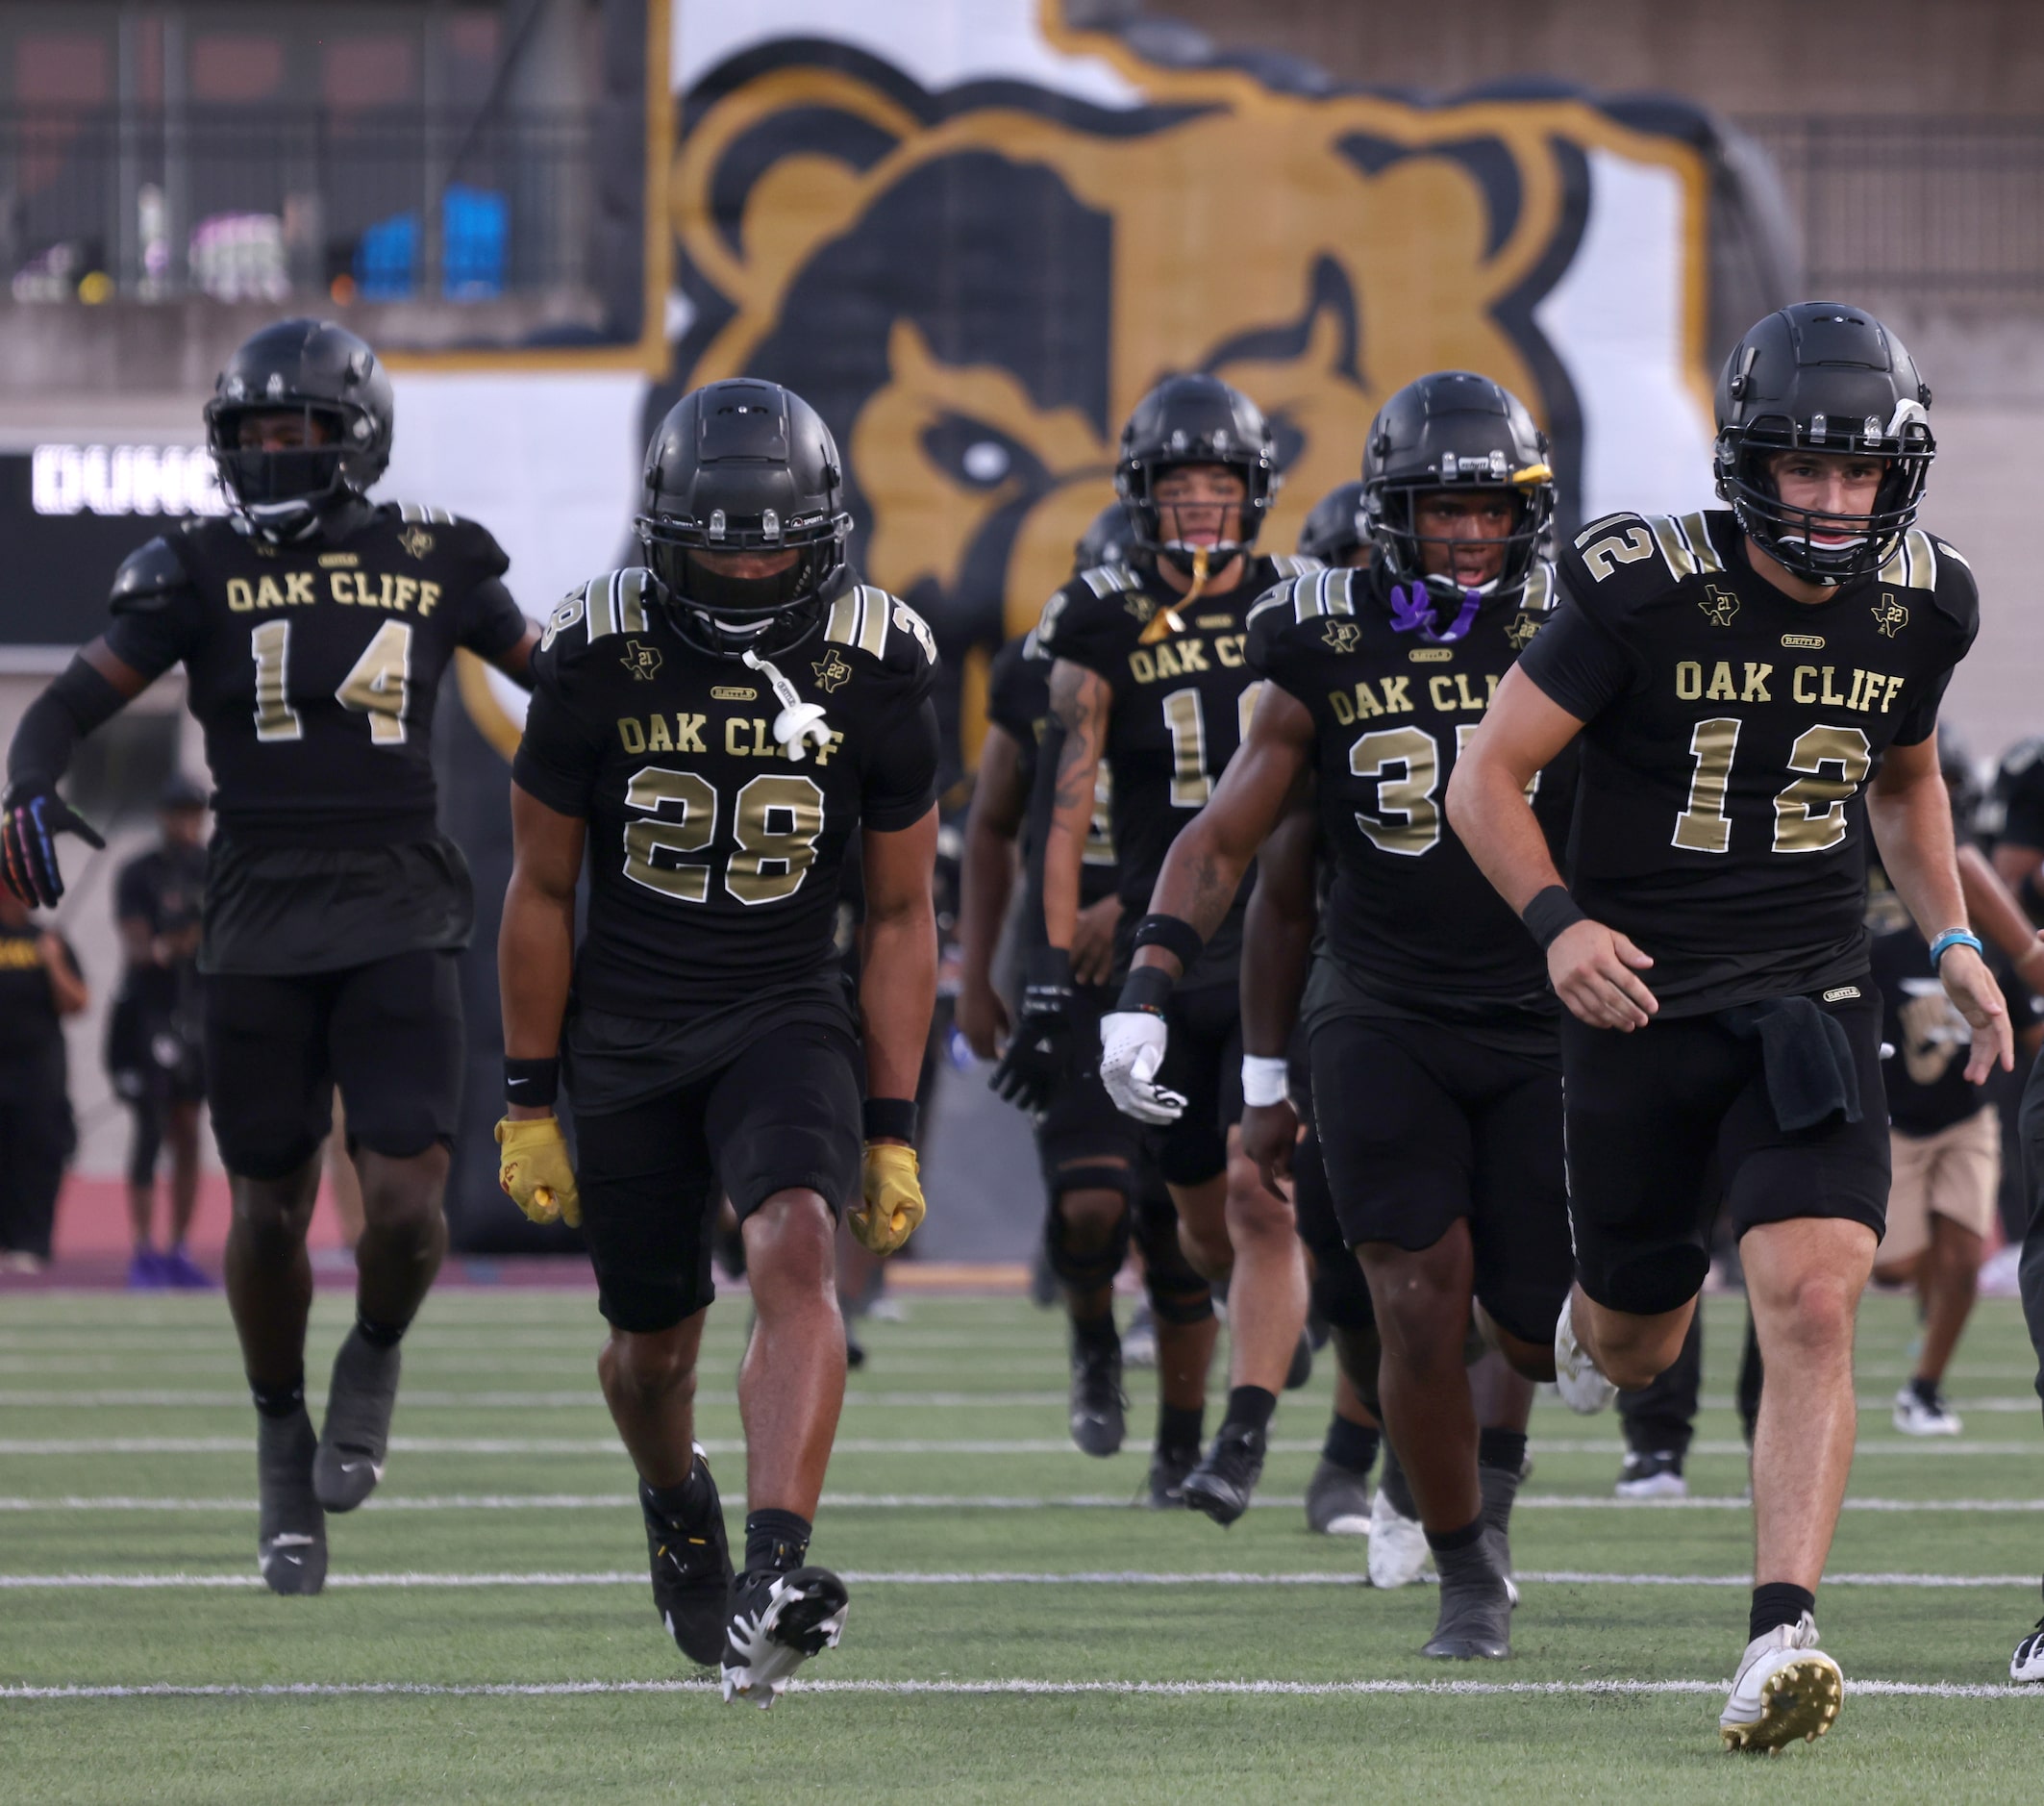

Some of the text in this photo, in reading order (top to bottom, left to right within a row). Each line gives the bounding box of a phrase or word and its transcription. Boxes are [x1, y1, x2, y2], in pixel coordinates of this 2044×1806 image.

[226, 571, 442, 617] OAK CLIFF
[1716, 595, 1732, 612] 21
[1886, 606, 1904, 622] 22
[637, 651, 653, 666] 21
[1128, 639, 1211, 684] OAK
[1783, 636, 1823, 648] BATTLE
[251, 618, 413, 744] 14
[826, 663, 846, 680] 22
[1676, 661, 1906, 714] OAK CLIFF
[1328, 675, 1415, 725] OAK
[616, 712, 845, 766] OAK CLF
[1162, 681, 1263, 808] 1
[1349, 724, 1482, 856] 3
[1670, 717, 1872, 854] 12
[622, 766, 825, 906] 28
